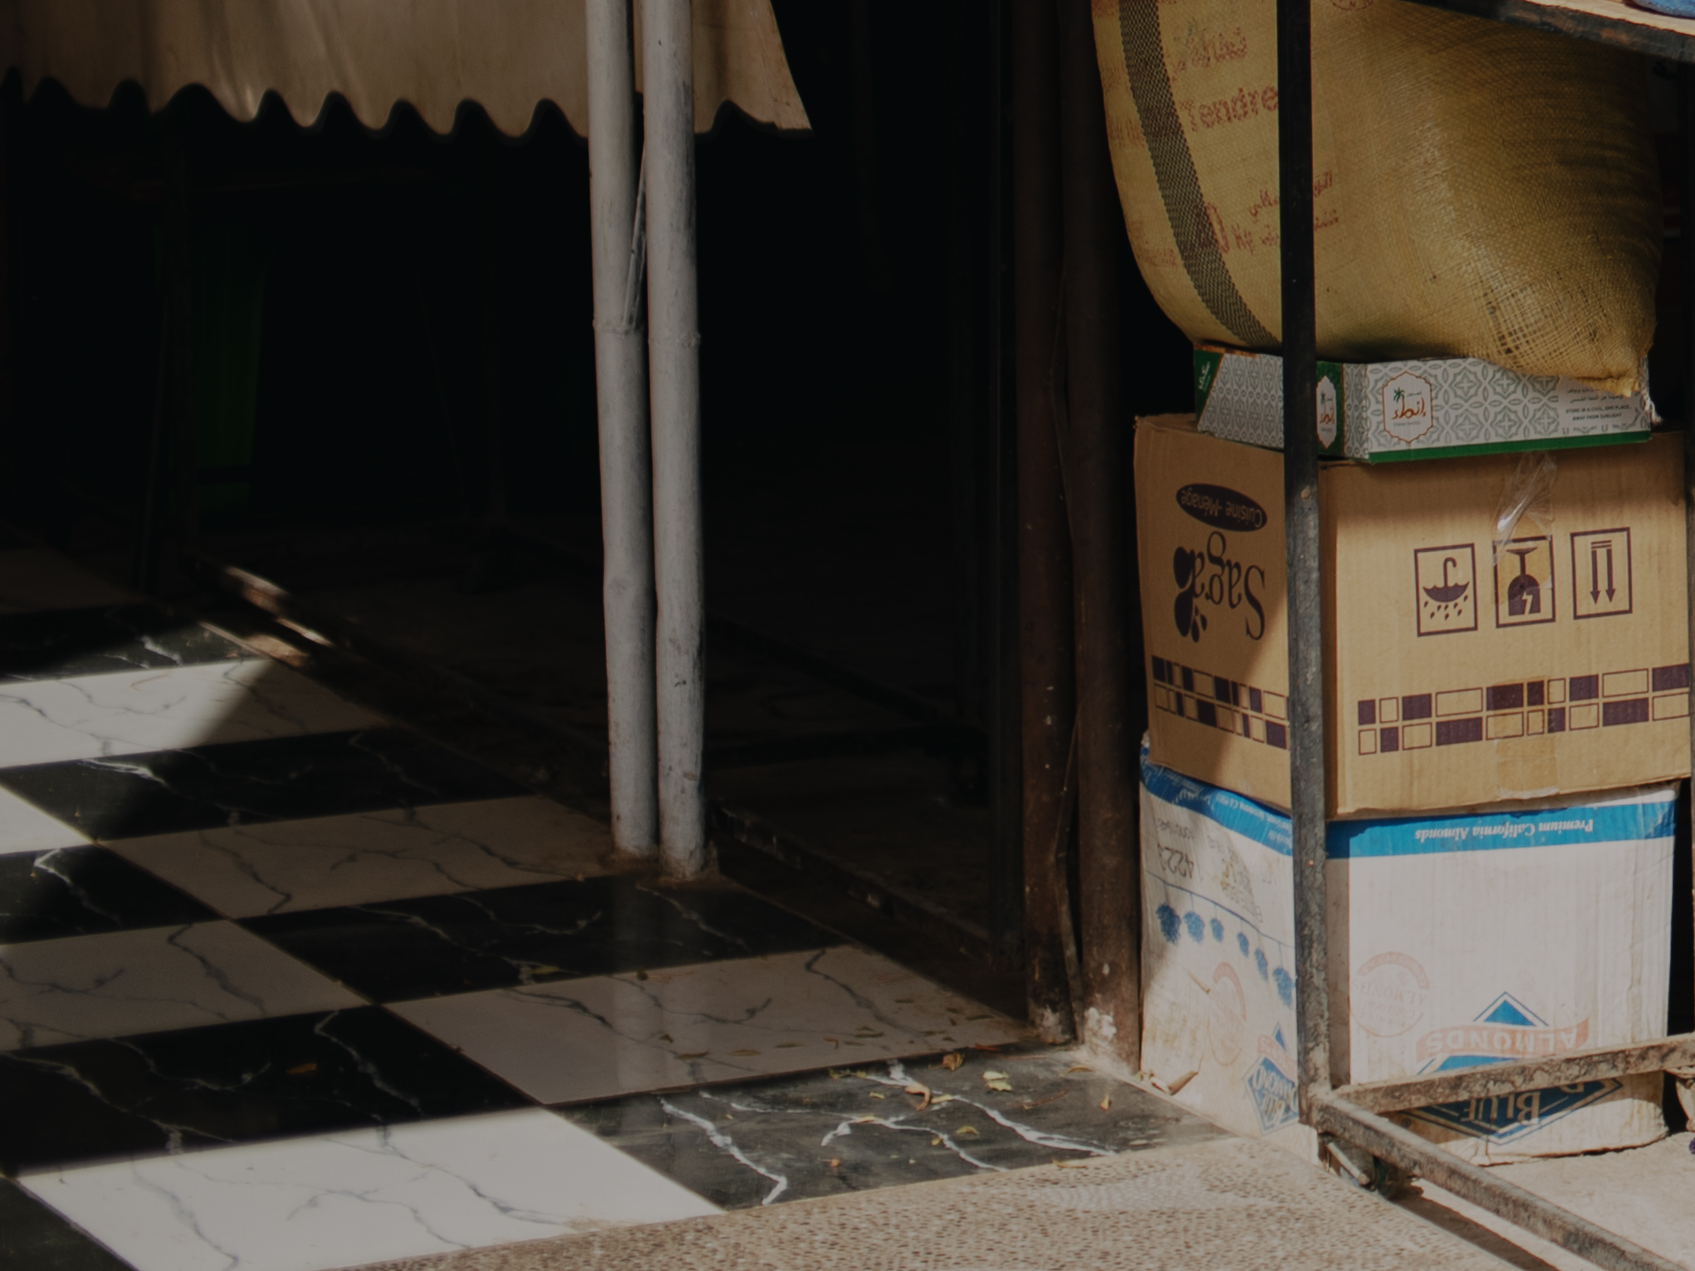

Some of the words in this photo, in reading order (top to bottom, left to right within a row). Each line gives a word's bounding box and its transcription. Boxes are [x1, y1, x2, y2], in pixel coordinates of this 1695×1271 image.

[1188, 531, 1266, 641] Saga
[1414, 825, 1470, 843] Almonds
[1472, 821, 1535, 839] California
[1538, 818, 1594, 835] Premium
[1424, 1027, 1579, 1055] ALMONDS
[1459, 1091, 1542, 1127] BLUE
